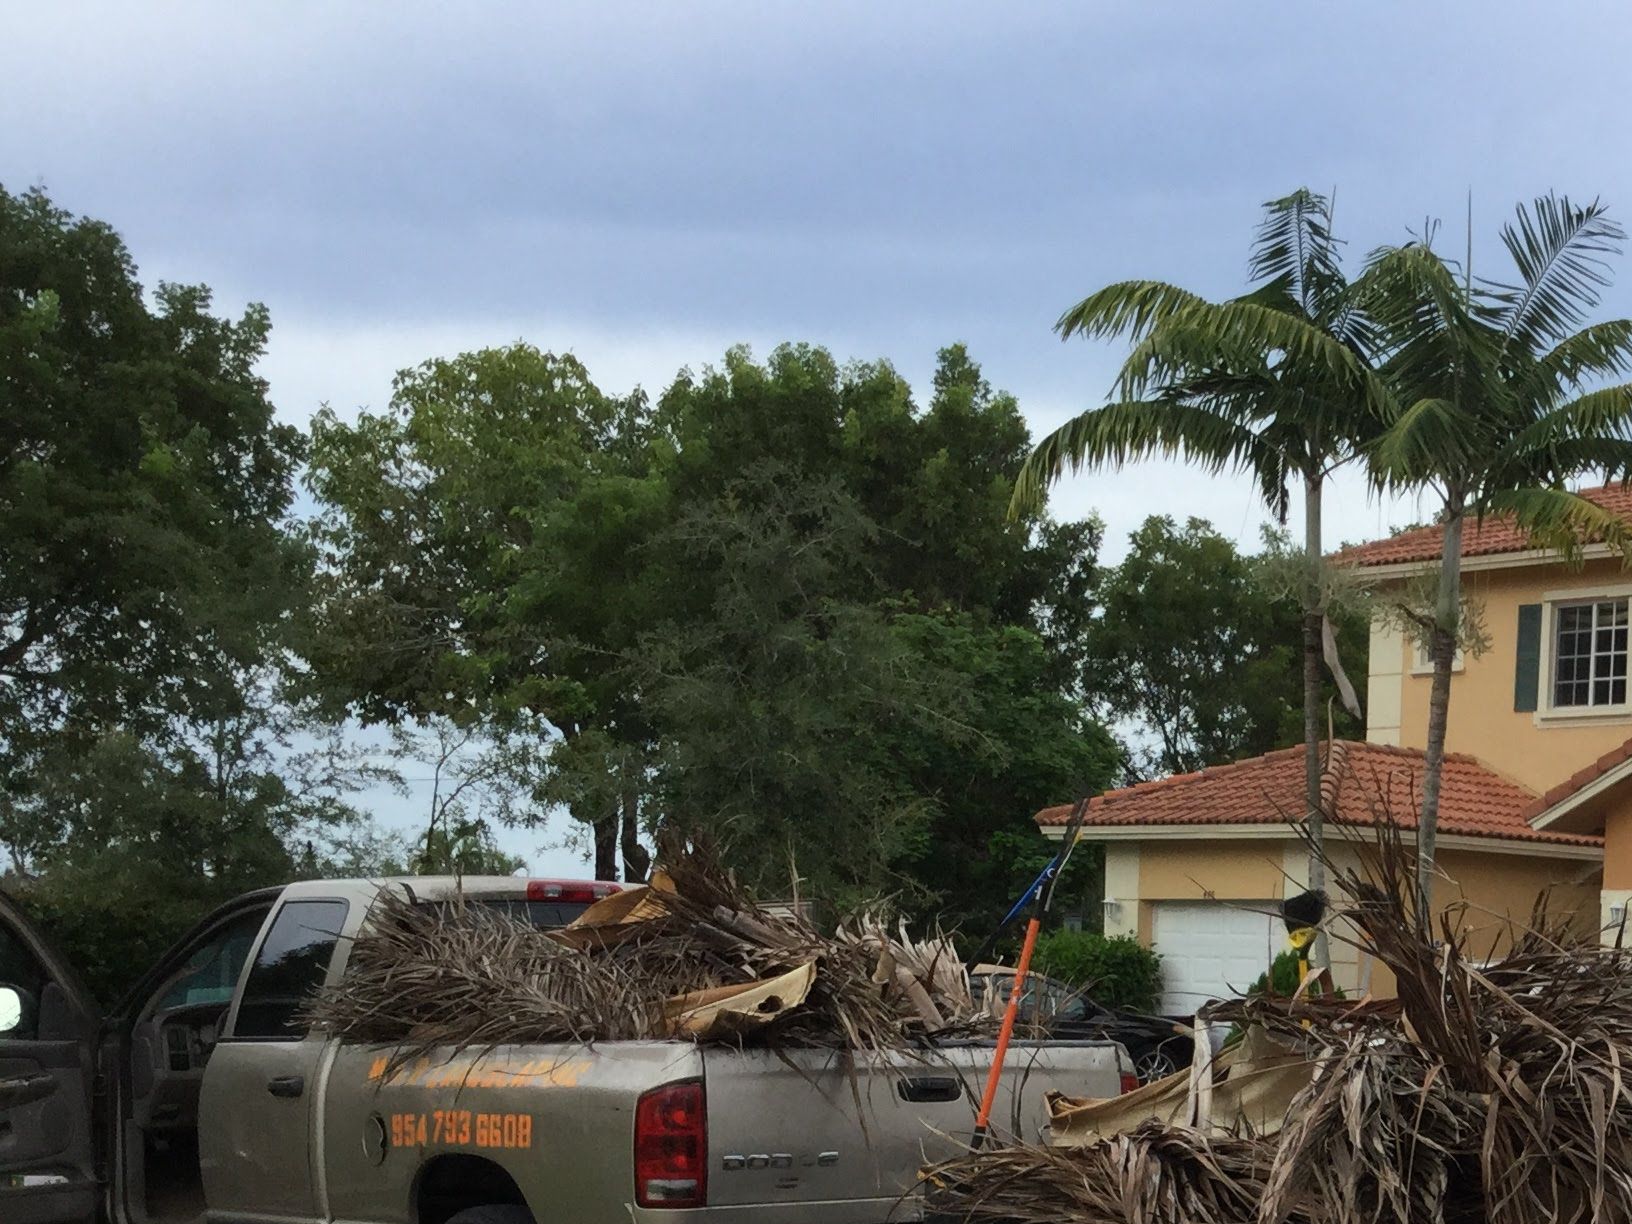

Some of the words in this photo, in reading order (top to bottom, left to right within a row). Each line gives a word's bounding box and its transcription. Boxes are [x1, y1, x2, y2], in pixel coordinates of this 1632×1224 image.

[391, 1113, 426, 1148] 954
[433, 1110, 471, 1145] 793
[475, 1113, 533, 1149] 6608
